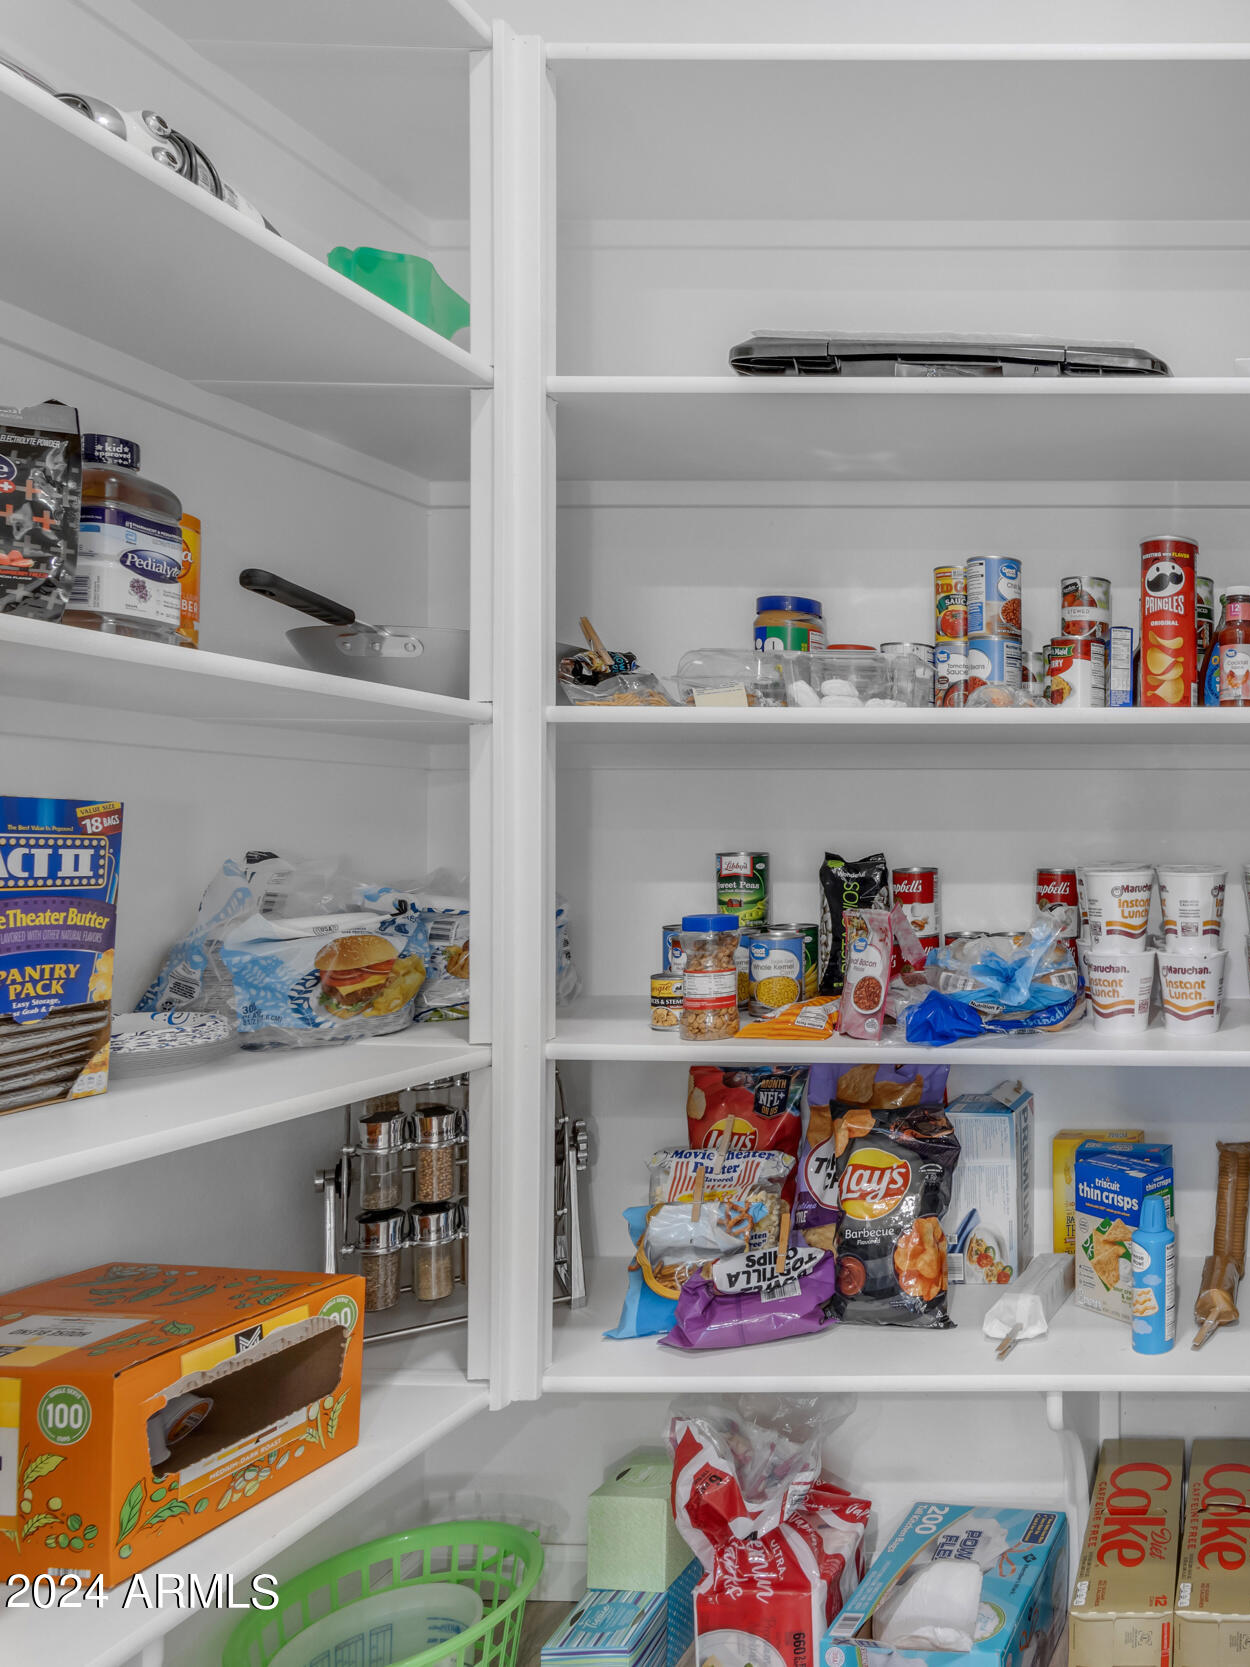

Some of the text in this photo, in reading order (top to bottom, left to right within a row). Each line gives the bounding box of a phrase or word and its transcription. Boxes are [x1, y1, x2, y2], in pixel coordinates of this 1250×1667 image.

[0, 434, 60, 448] ELECTROLYTE POWDER
[105, 442, 123, 452] kid
[95, 451, 131, 459] approved
[125, 552, 181, 579] Pedialyte
[945, 598, 968, 606] SAUC
[1145, 595, 1184, 616] PRINGLES
[80, 803, 115, 816] VALUE SIZE
[81, 814, 120, 834] 18 BAGS
[58, 848, 94, 877] II
[1118, 898, 1150, 909] Instan
[6, 908, 110, 930] Theater Butter
[858, 959, 877, 968] Bacon
[1167, 965, 1209, 975] Maruchan
[8, 980, 66, 1000] PACK
[1165, 978, 1206, 990] Instant
[1169, 990, 1202, 1000] Lunch
[12, 1001, 31, 1010] Easy
[970, 1001, 996, 1010] Nutrition
[760, 1079, 786, 1090] MONTH
[761, 1106, 778, 1116] ON US
[670, 1150, 776, 1162] Movie heater
[692, 1161, 740, 1176] Buter
[1020, 1103, 1029, 1237] PREMIUM
[842, 1163, 906, 1203] Lay's
[1096, 1176, 1120, 1192] triscuit
[1146, 1178, 1172, 1192] thin crisps
[1078, 1182, 1102, 1203] thin
[1102, 1189, 1138, 1210] crisps
[844, 1227, 894, 1239] Barbecue
[67, 1388, 82, 1400] SERVE
[46, 1403, 84, 1430] 100
[260, 1438, 282, 1455] ROAST
[915, 1505, 950, 1535] 200
[1088, 1481, 1108, 1548] CAFFEINE FREE
[1096, 1462, 1172, 1568] Coke
[1187, 1482, 1201, 1550] CAFFEINE FREE
[934, 1534, 960, 1561] FLE
[954, 1530, 983, 1561] POW
[1150, 1528, 1172, 1560] Diet
[770, 1539, 787, 1575] ULTRA
[1154, 1594, 1168, 1607] 12
[793, 1632, 806, 1655] 660
